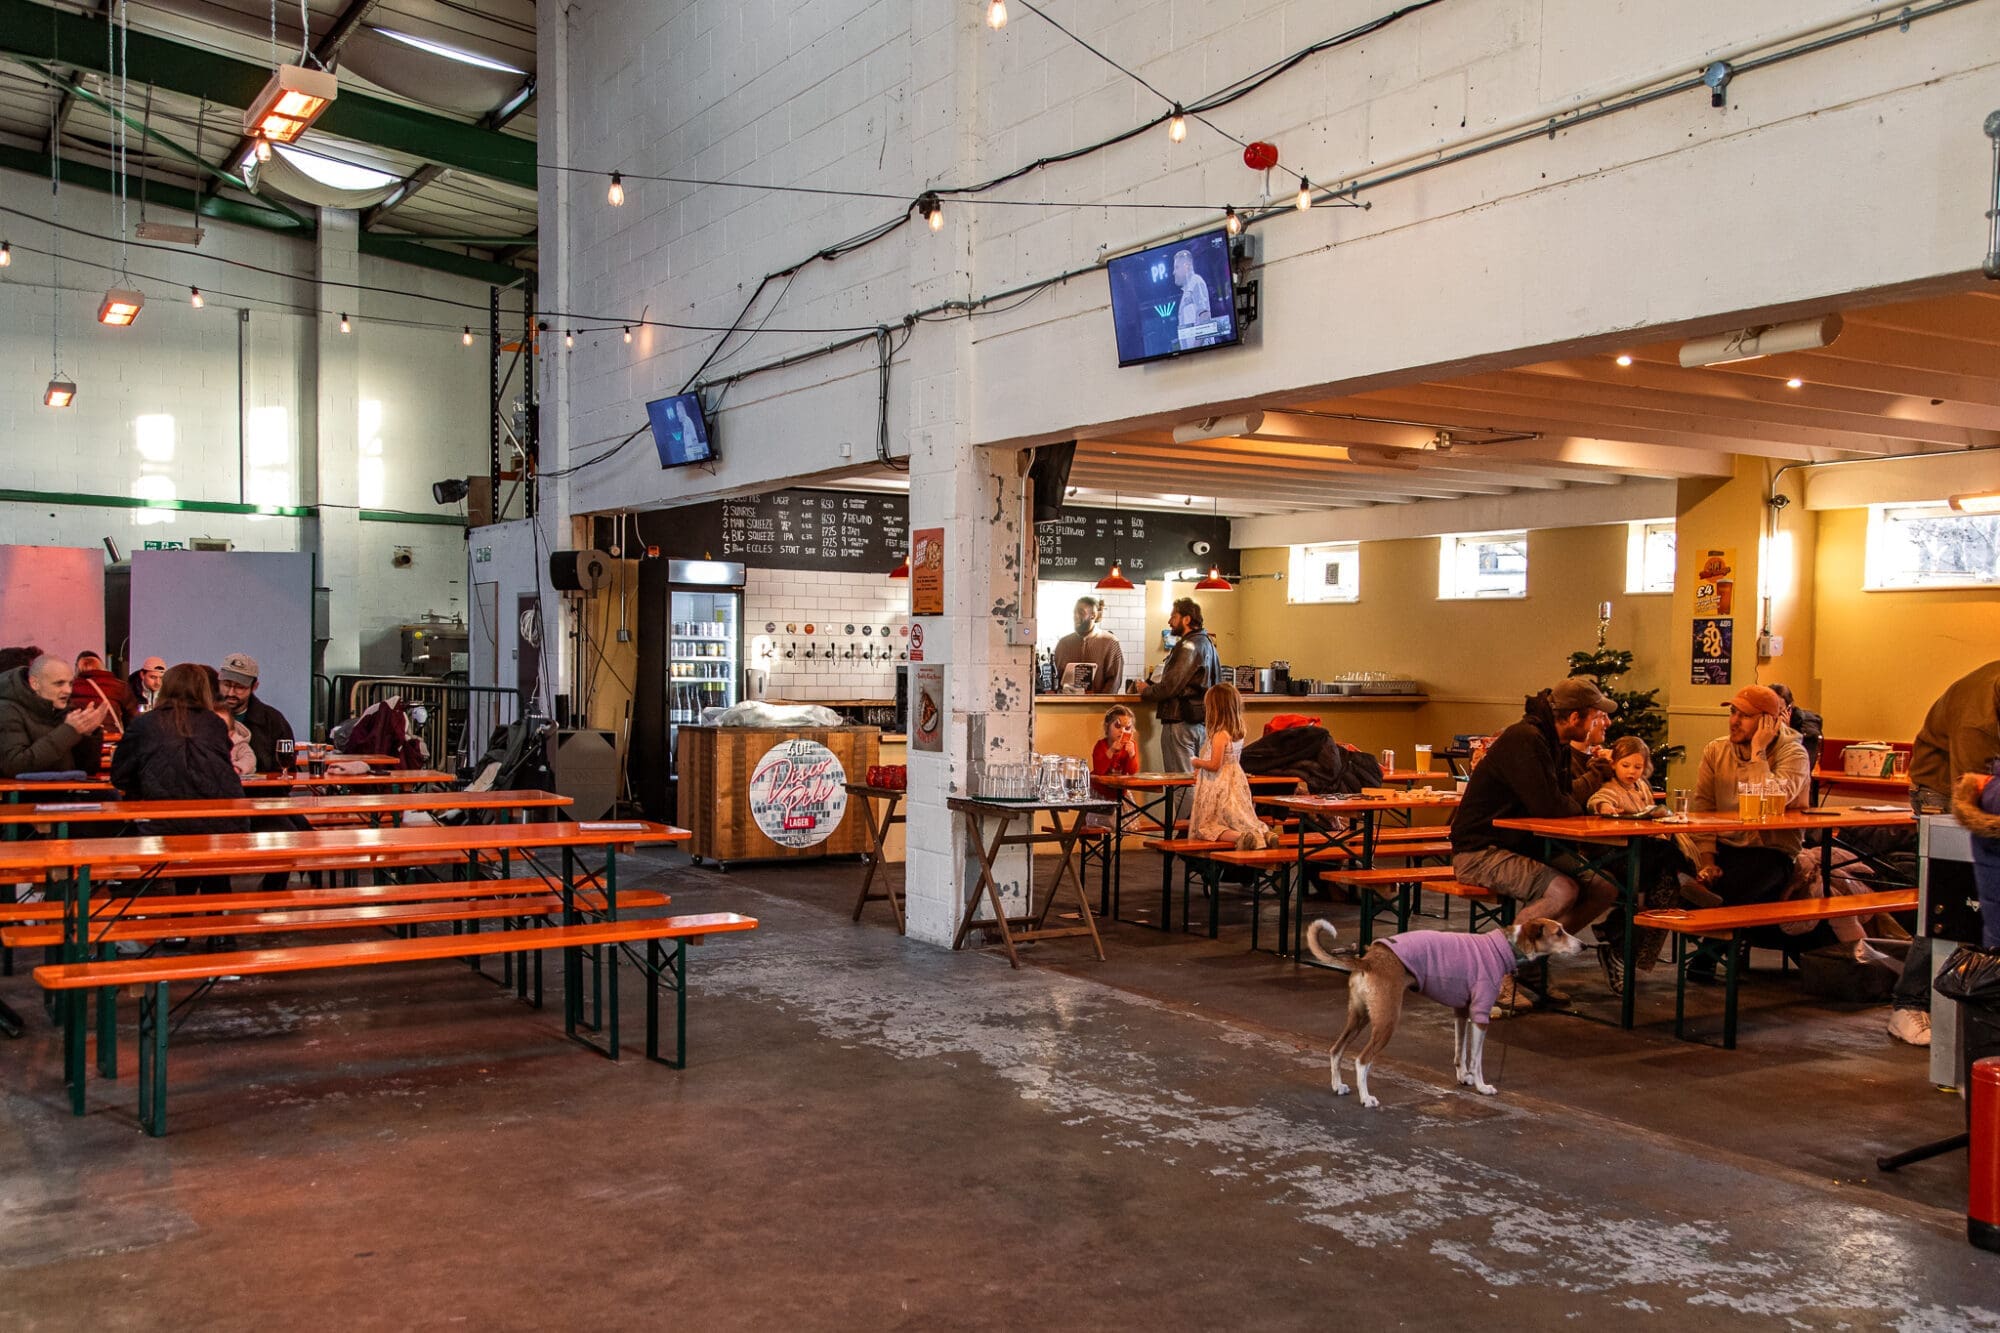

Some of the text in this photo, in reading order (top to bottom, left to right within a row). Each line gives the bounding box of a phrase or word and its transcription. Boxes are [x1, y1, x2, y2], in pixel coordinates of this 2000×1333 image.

[772, 496, 790, 505] LAGER
[842, 498, 848, 508] 6
[722, 506, 756, 517] 2 SUNRISE
[842, 512, 872, 525] 7 REWIND
[722, 518, 728, 528] 3
[730, 518, 744, 528] MAN
[746, 518, 774, 530] SQUEEZE
[722, 532, 730, 542] 4
[732, 530, 744, 542] BIG
[748, 531, 776, 541] SQUEEZE
[784, 532, 794, 541] IPA
[842, 526, 860, 536] 8 JAM
[842, 536, 846, 546] 9
[724, 544, 730, 554] 5
[746, 544, 773, 553] ECCLES
[840, 548, 848, 557] 10
[1697, 585, 1713, 597] £4
[751, 758, 832, 804] Disco
[789, 818, 808, 827] LAGER
